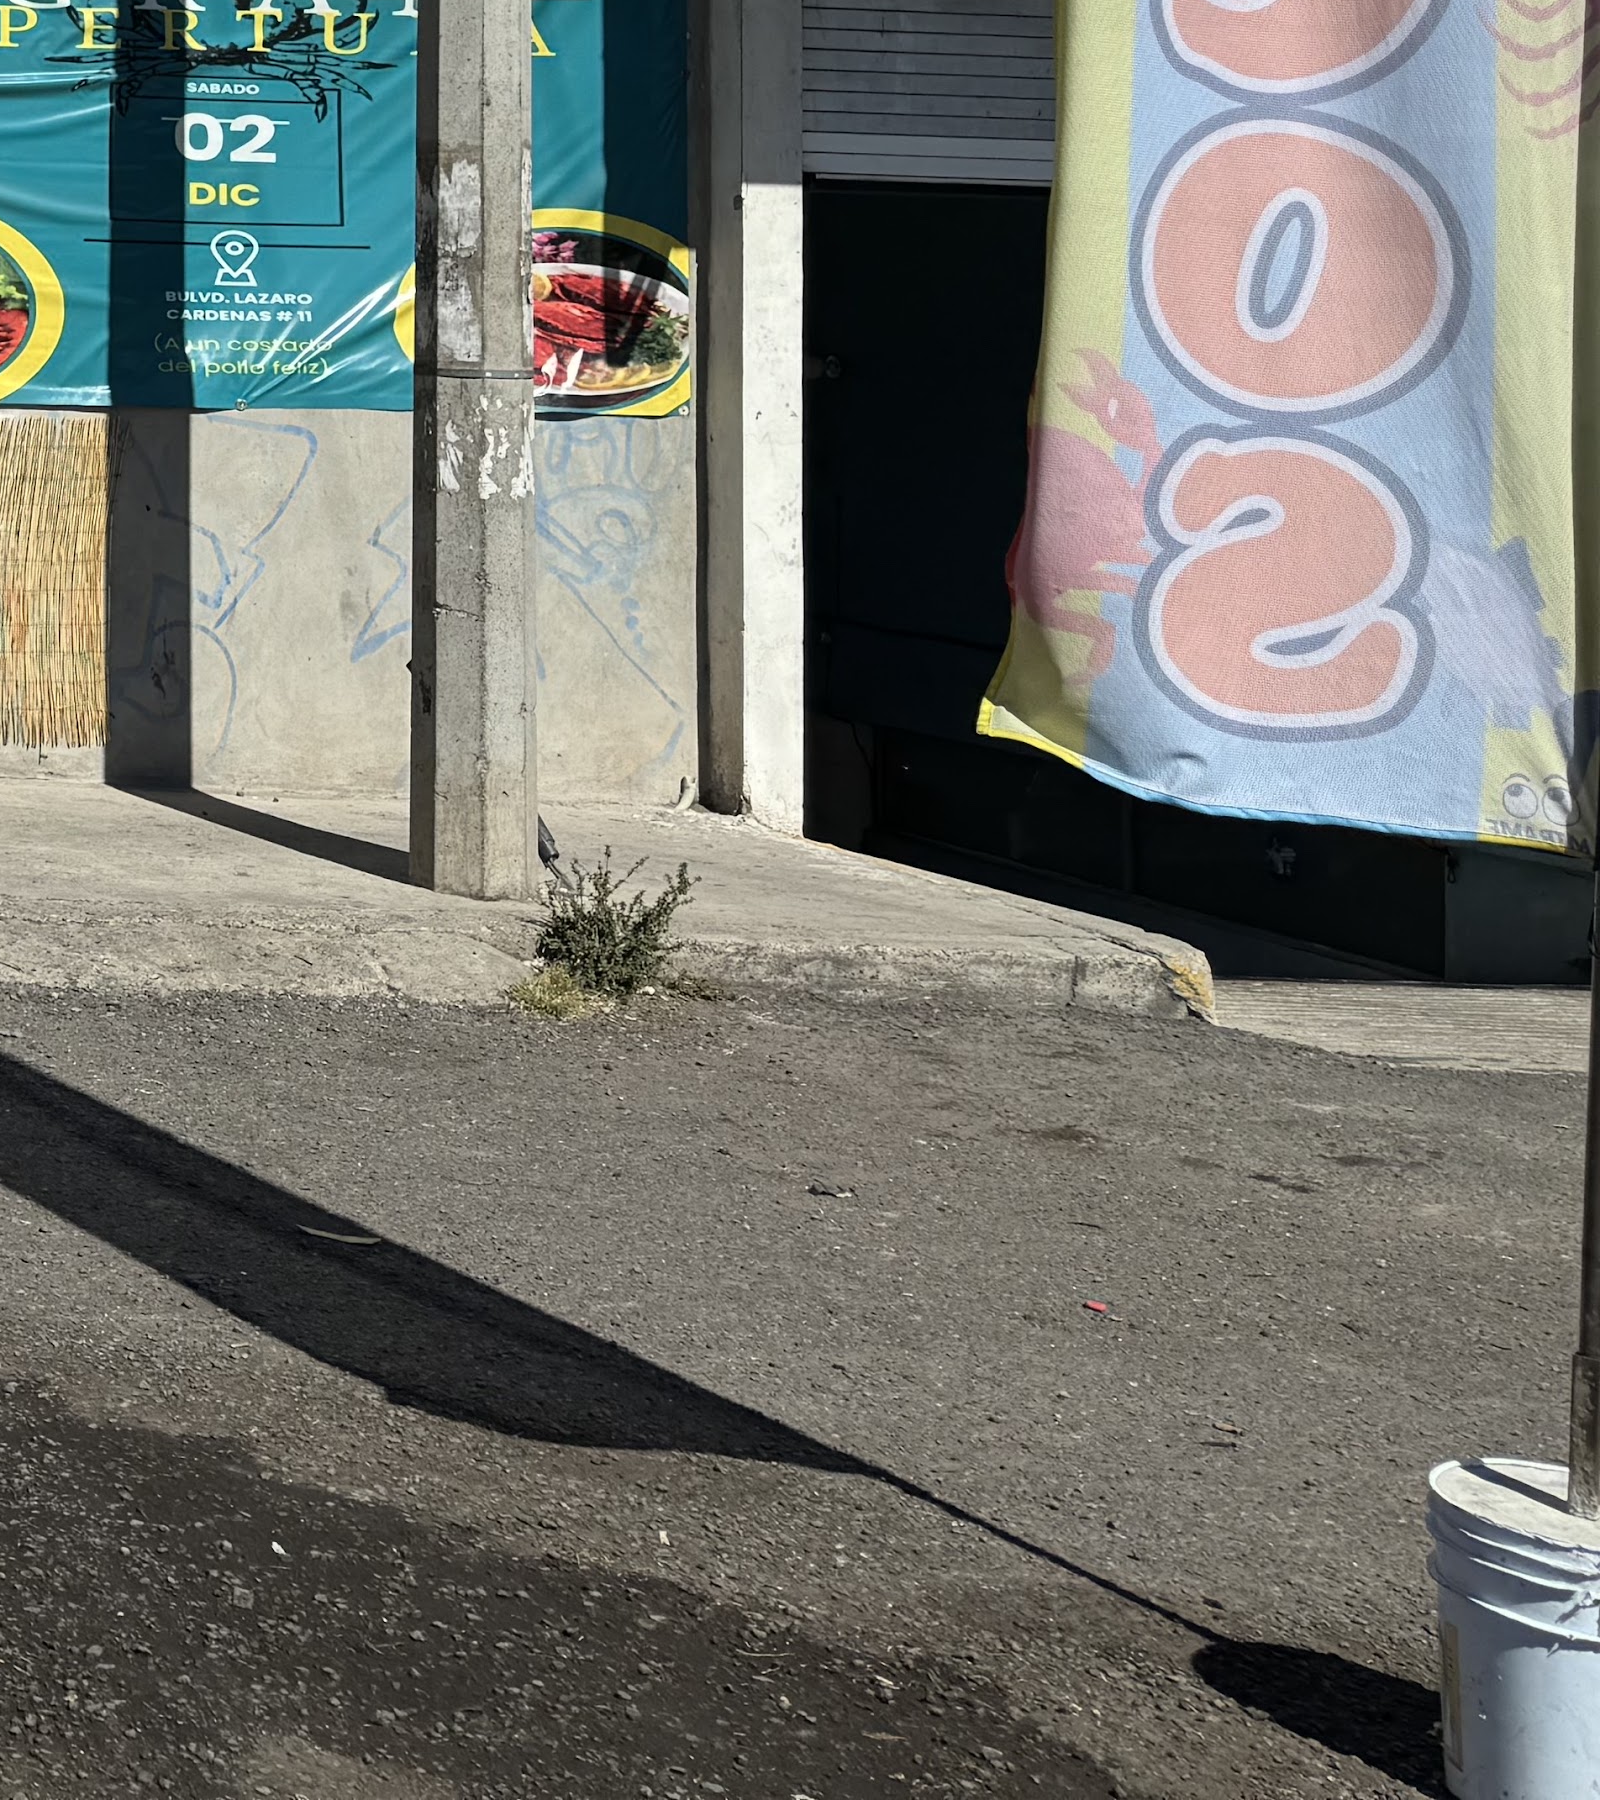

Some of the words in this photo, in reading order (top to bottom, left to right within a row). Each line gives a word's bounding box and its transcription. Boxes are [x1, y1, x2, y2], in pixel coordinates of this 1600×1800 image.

[186, 81, 260, 95] SABADO
[174, 111, 277, 163] 02
[188, 181, 261, 207] DIC
[164, 290, 230, 304] BULVD.
[234, 291, 313, 305] LAZARO
[166, 308, 272, 322] CARDENAS
[276, 310, 293, 322] #
[298, 309, 313, 322] 11
[185, 339, 220, 352] un
[226, 337, 332, 353] costado
[157, 359, 196, 374] del
[204, 360, 266, 378] pollo
